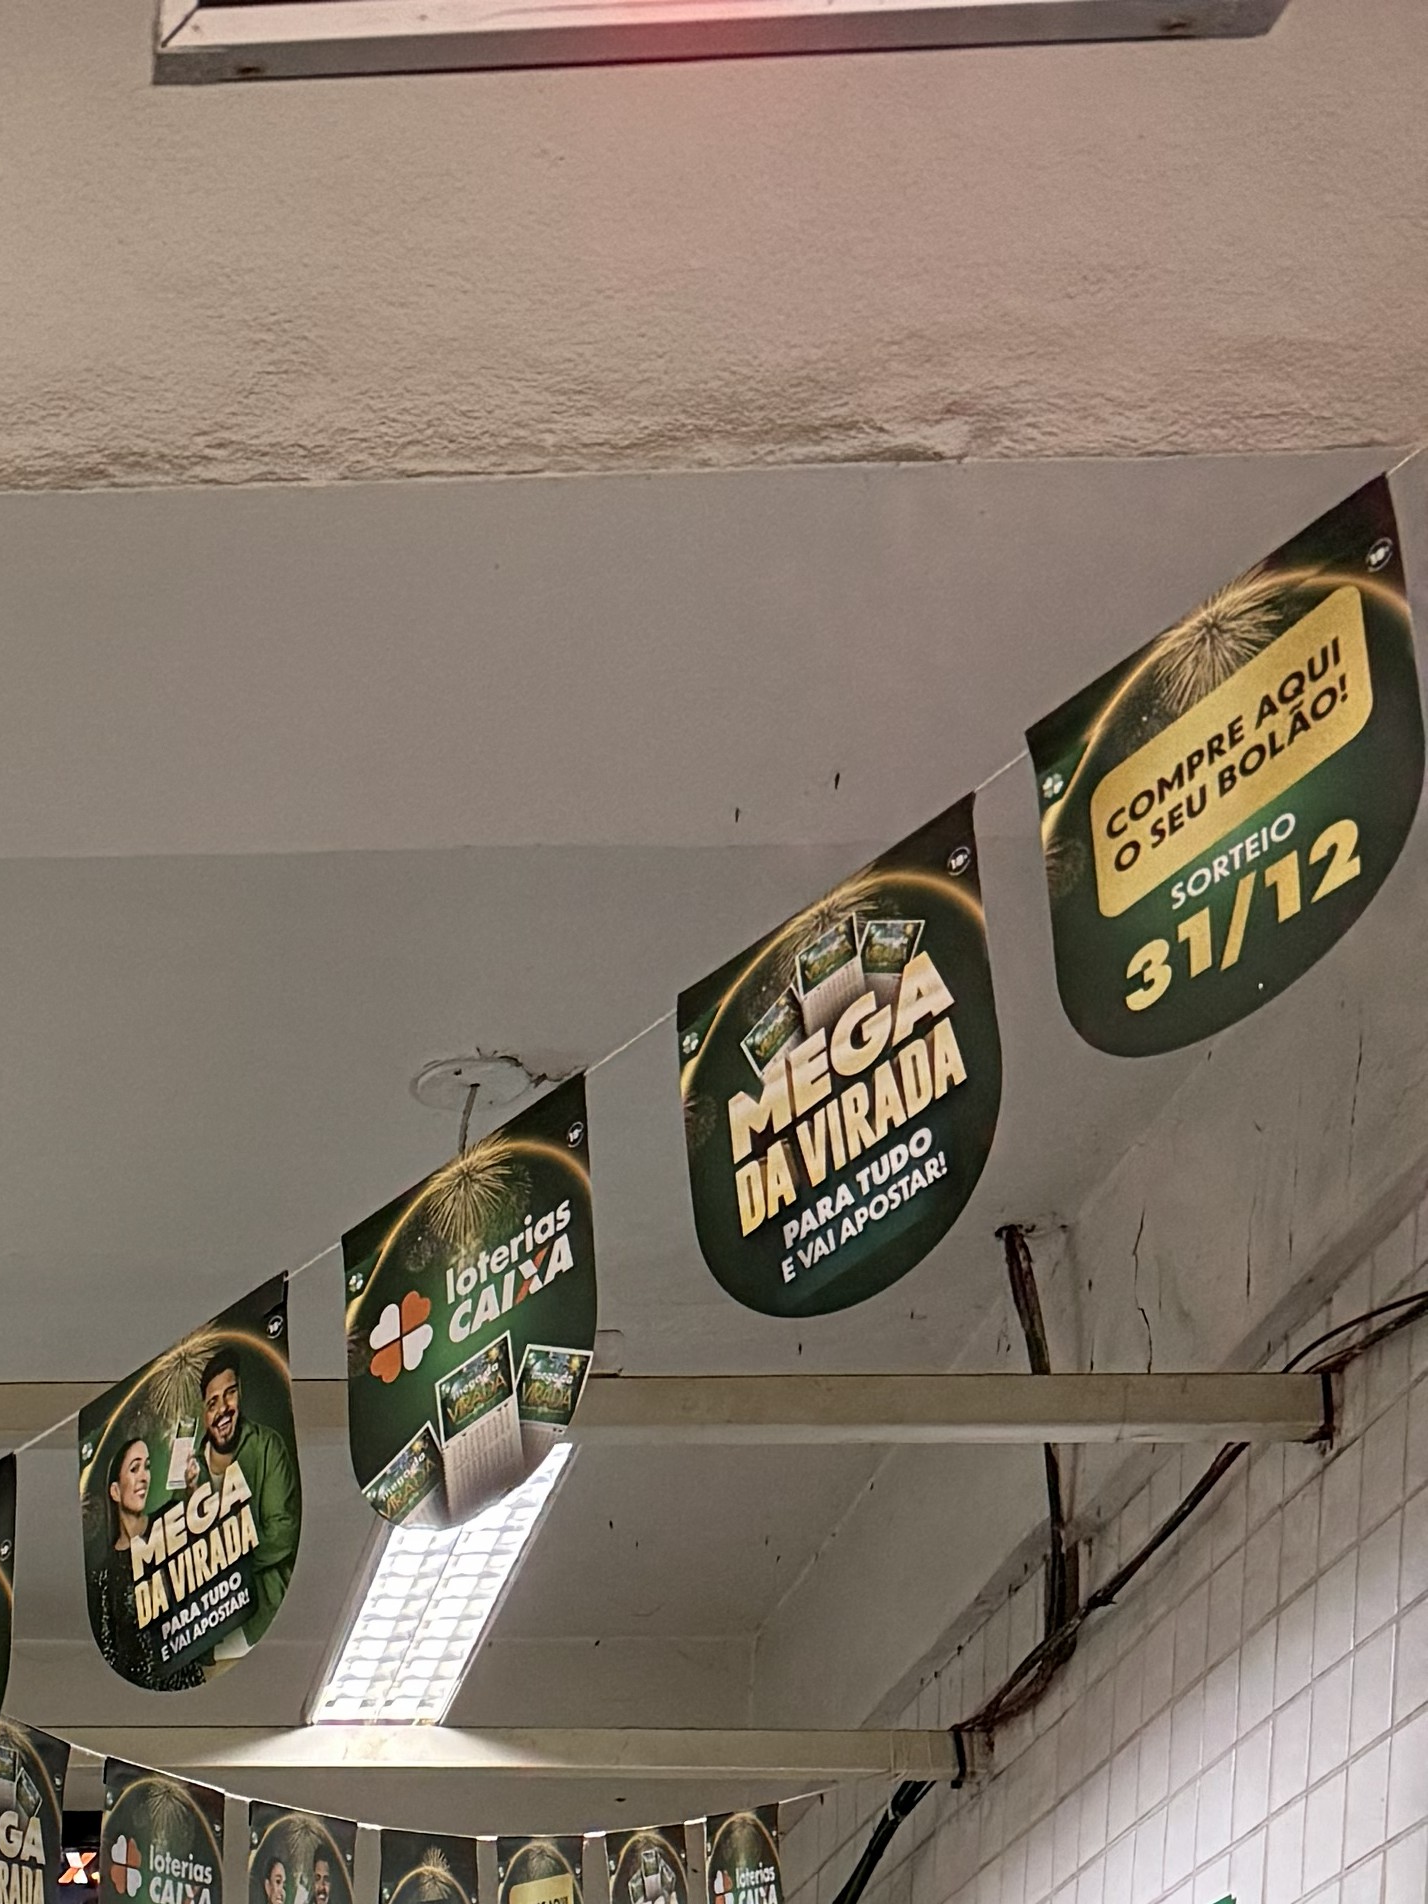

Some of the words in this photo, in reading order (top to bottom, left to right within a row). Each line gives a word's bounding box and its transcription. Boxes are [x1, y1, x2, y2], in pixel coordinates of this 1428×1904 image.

[1105, 714, 1246, 840] COMPRE
[1255, 636, 1343, 731] AQUI
[1114, 837, 1141, 872] O
[1150, 798, 1207, 852] SEU
[1218, 676, 1350, 811] BOLÃO!
[1124, 818, 1362, 1013] 31/12
[1171, 812, 1297, 911] SORTEIO
[728, 951, 955, 1165] MEGA
[736, 1143, 796, 1238] DA
[805, 1018, 967, 1191] VIRADA
[446, 1200, 570, 1305] loterias
[781, 1255, 796, 1285] E
[799, 1234, 835, 1269] VAI
[839, 1153, 948, 1250] APOSTAR!
[782, 1181, 853, 1250] PARA
[856, 1127, 934, 1204] TUDO
[449, 1232, 573, 1344] CAIXA
